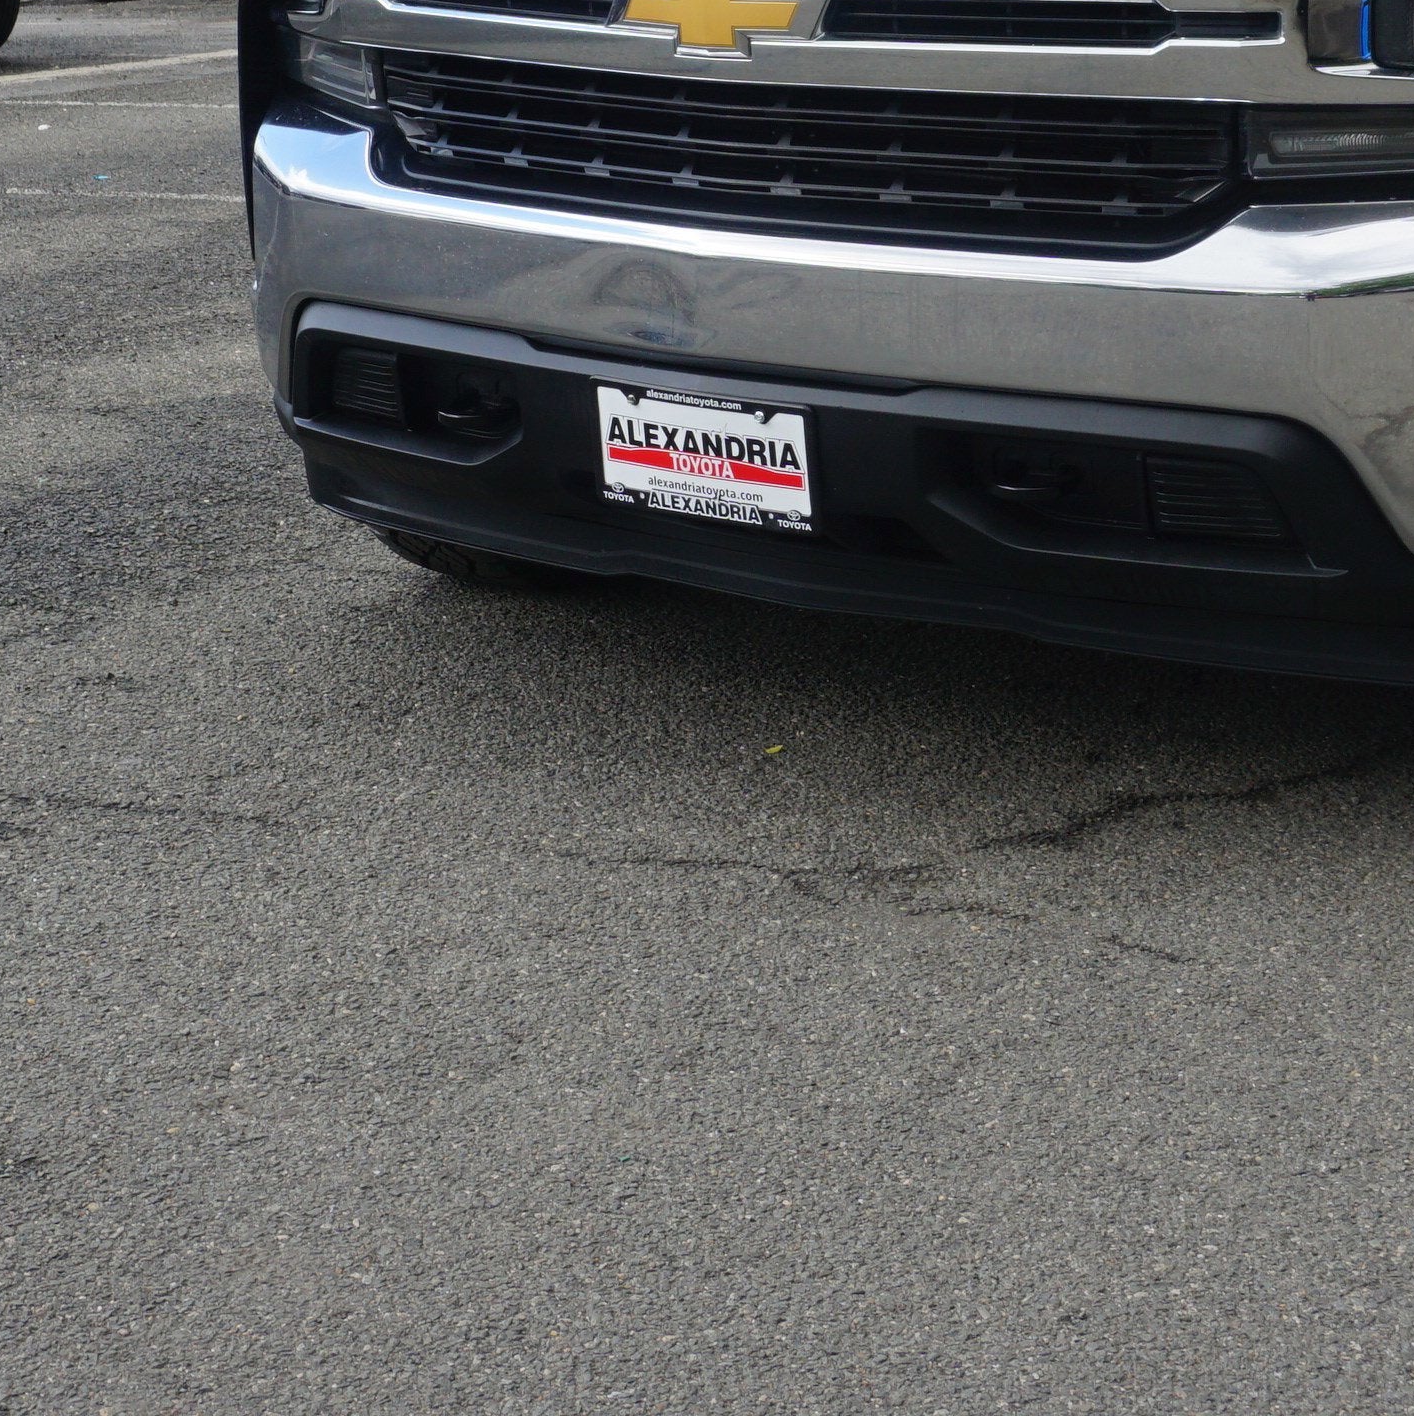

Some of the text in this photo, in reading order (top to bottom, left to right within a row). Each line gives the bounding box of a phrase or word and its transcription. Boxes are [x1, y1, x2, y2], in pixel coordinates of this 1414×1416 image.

[646, 388, 742, 412] alexandriatoyota.com
[608, 416, 801, 471] ALEXANDRIA
[669, 452, 735, 479] TOYOTA
[648, 475, 763, 503] alexandriatoyota.com
[602, 490, 812, 532] TOYOTA ALEXANDRIA TOYOTA
